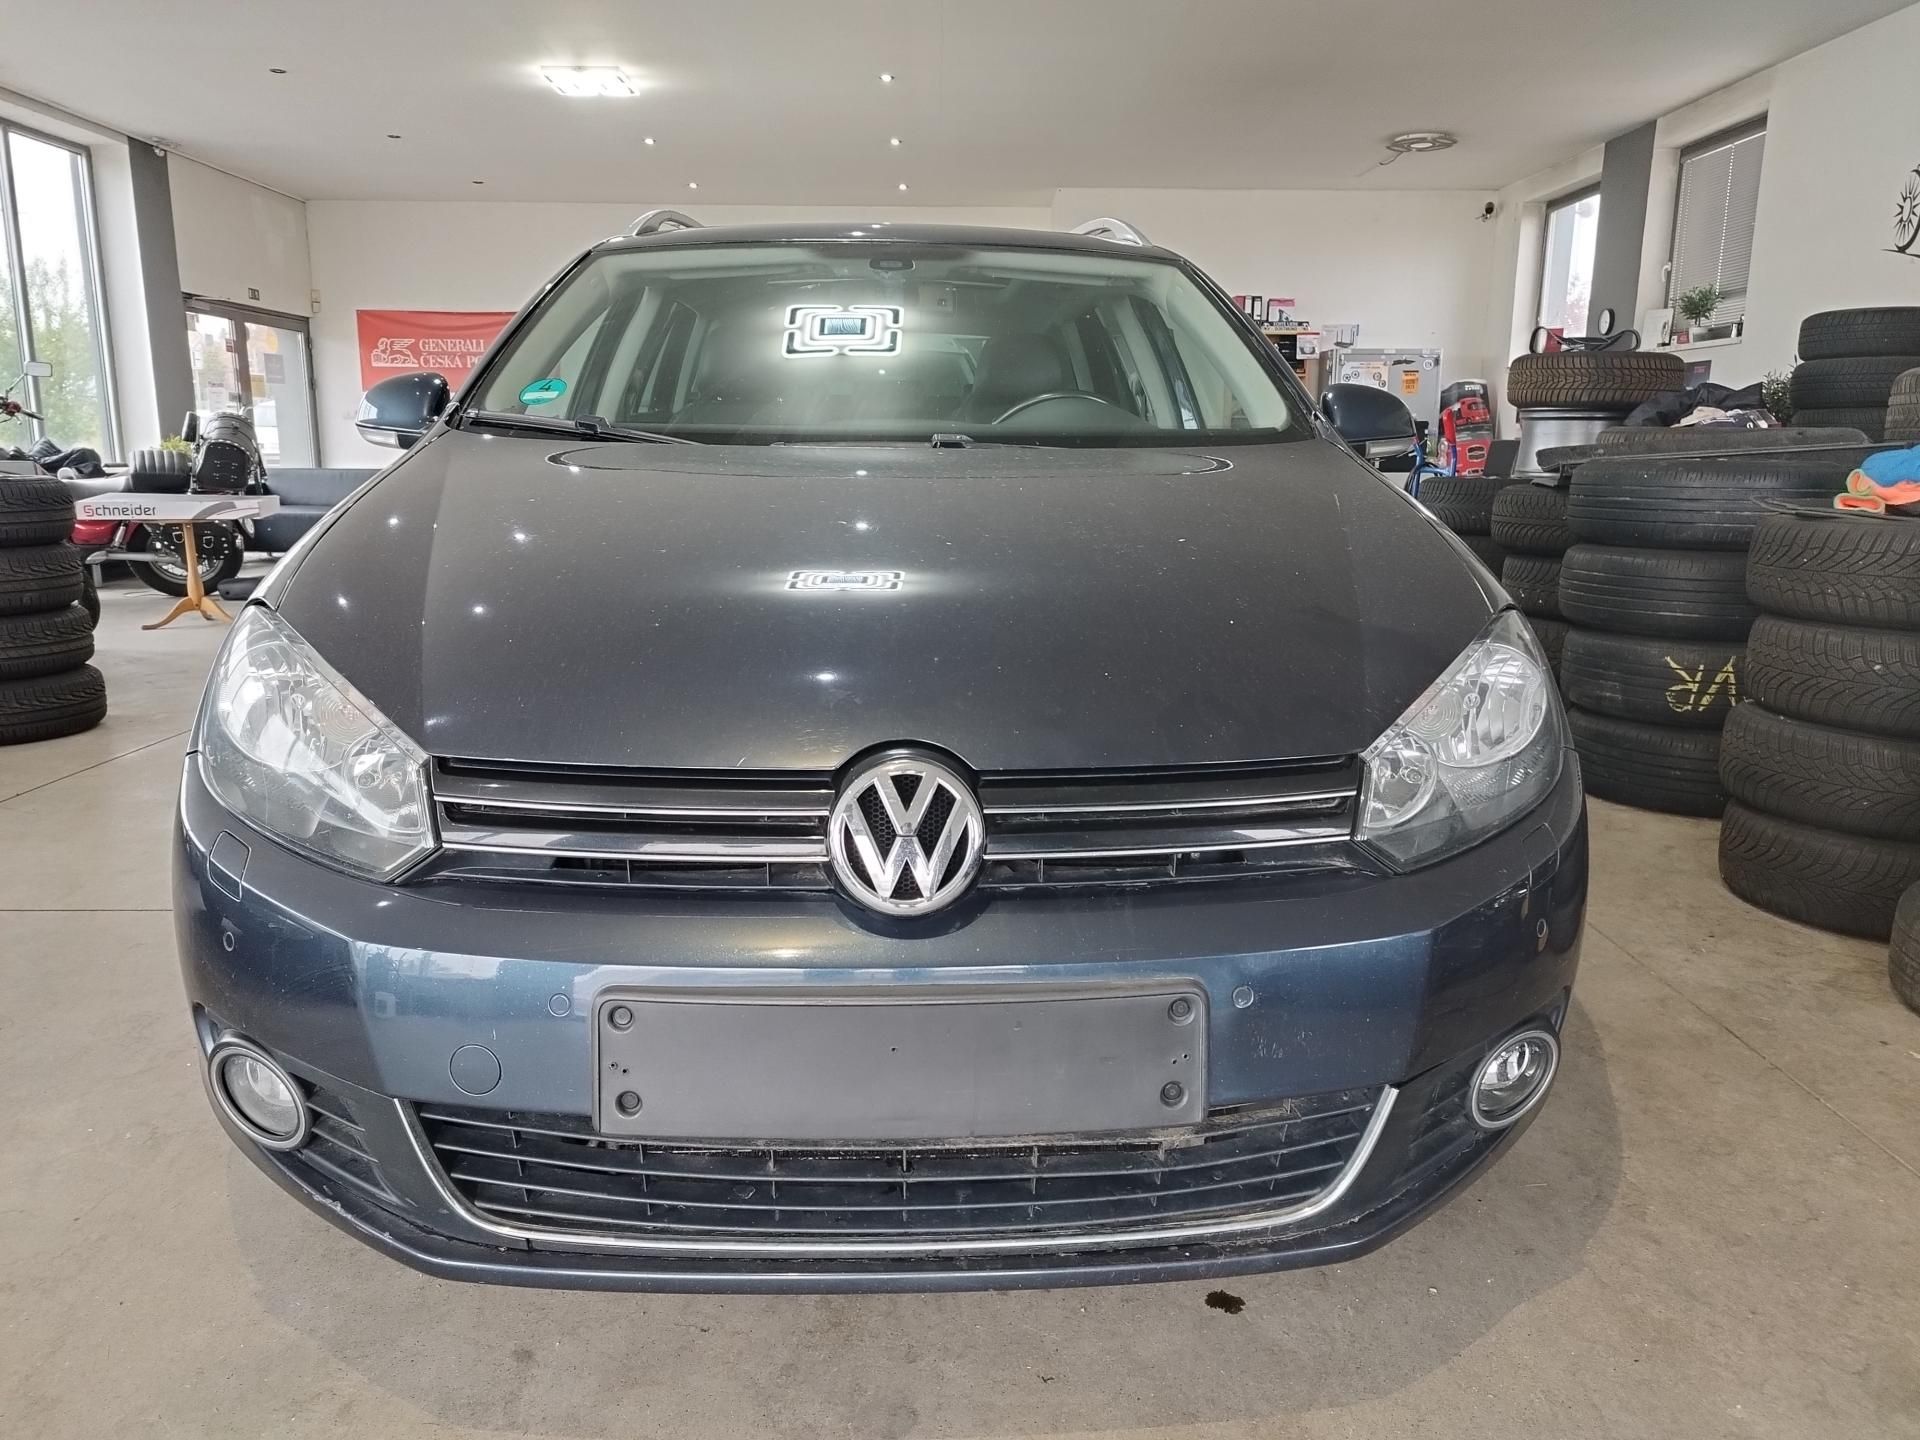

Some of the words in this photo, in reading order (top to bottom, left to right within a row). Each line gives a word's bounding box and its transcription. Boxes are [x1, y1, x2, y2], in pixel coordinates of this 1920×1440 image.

[419, 338, 485, 352] GENERALI
[420, 352, 463, 368] ČESKÁ
[538, 380, 552, 391] 4
[83, 504, 156, 517] Schneider
[834, 764, 980, 909] VW
